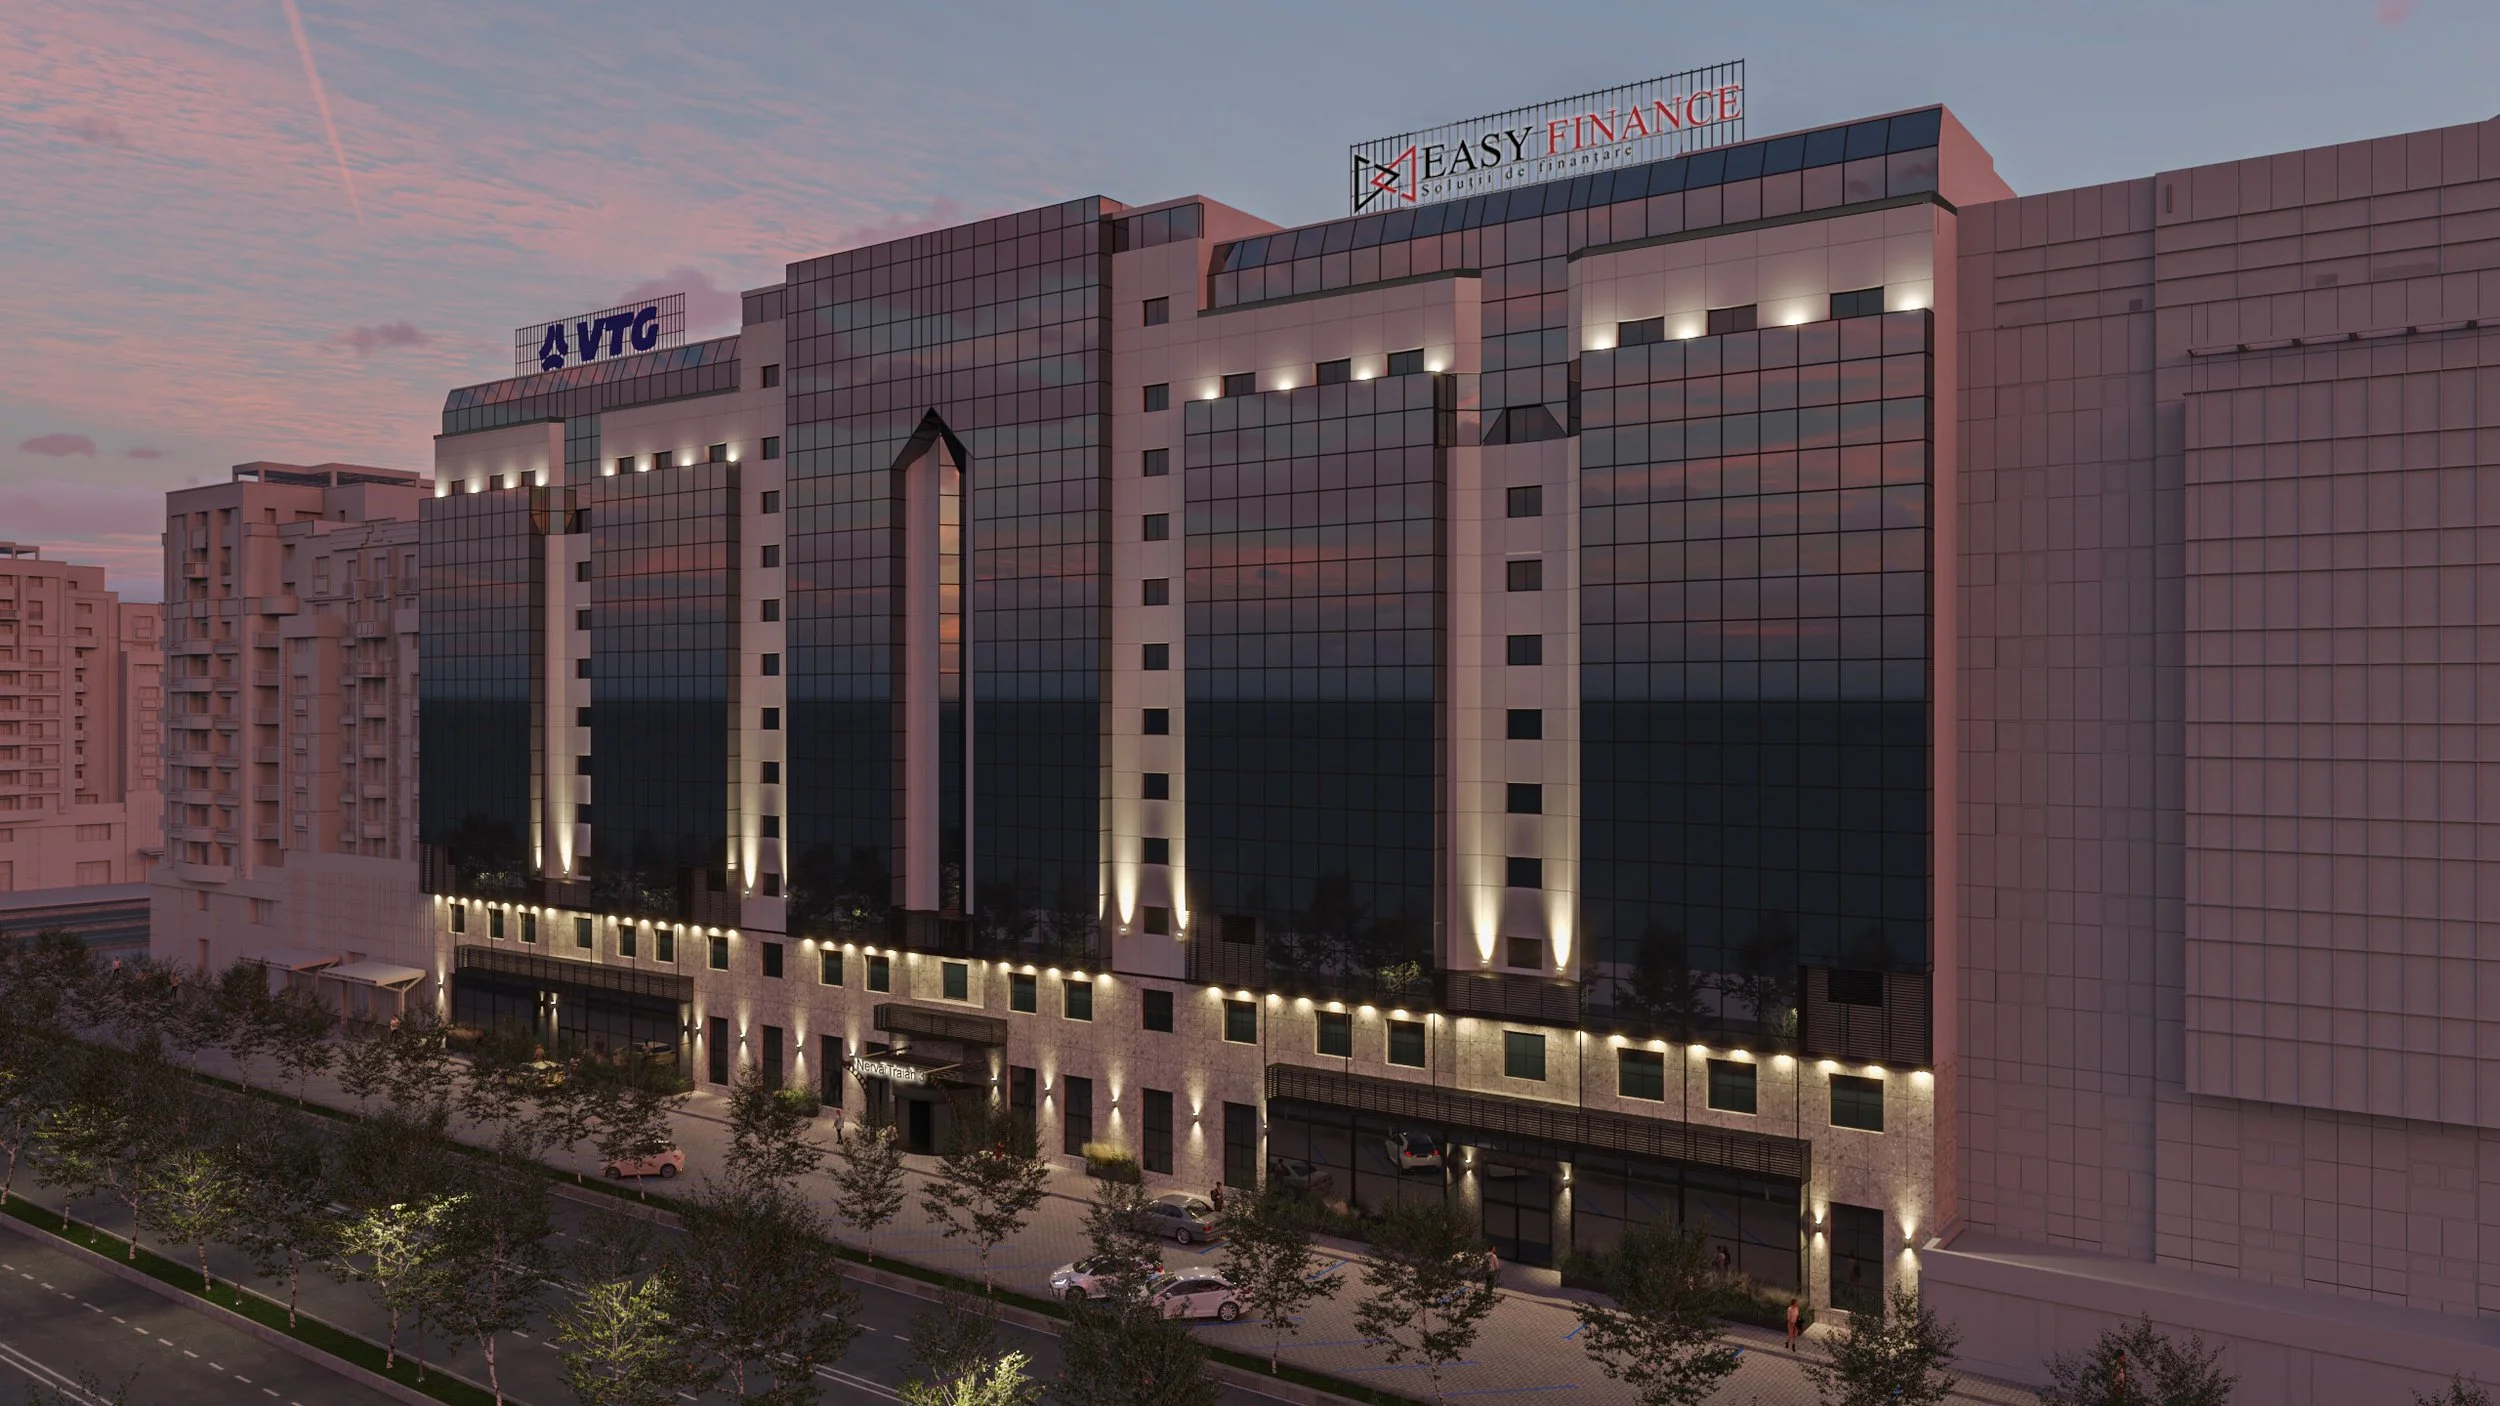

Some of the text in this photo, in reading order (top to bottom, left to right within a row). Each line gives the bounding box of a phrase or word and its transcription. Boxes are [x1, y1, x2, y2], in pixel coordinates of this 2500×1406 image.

[1422, 84, 1742, 180] EASY FINANCE
[1505, 166, 1526, 180] de
[576, 305, 660, 362] VTG
